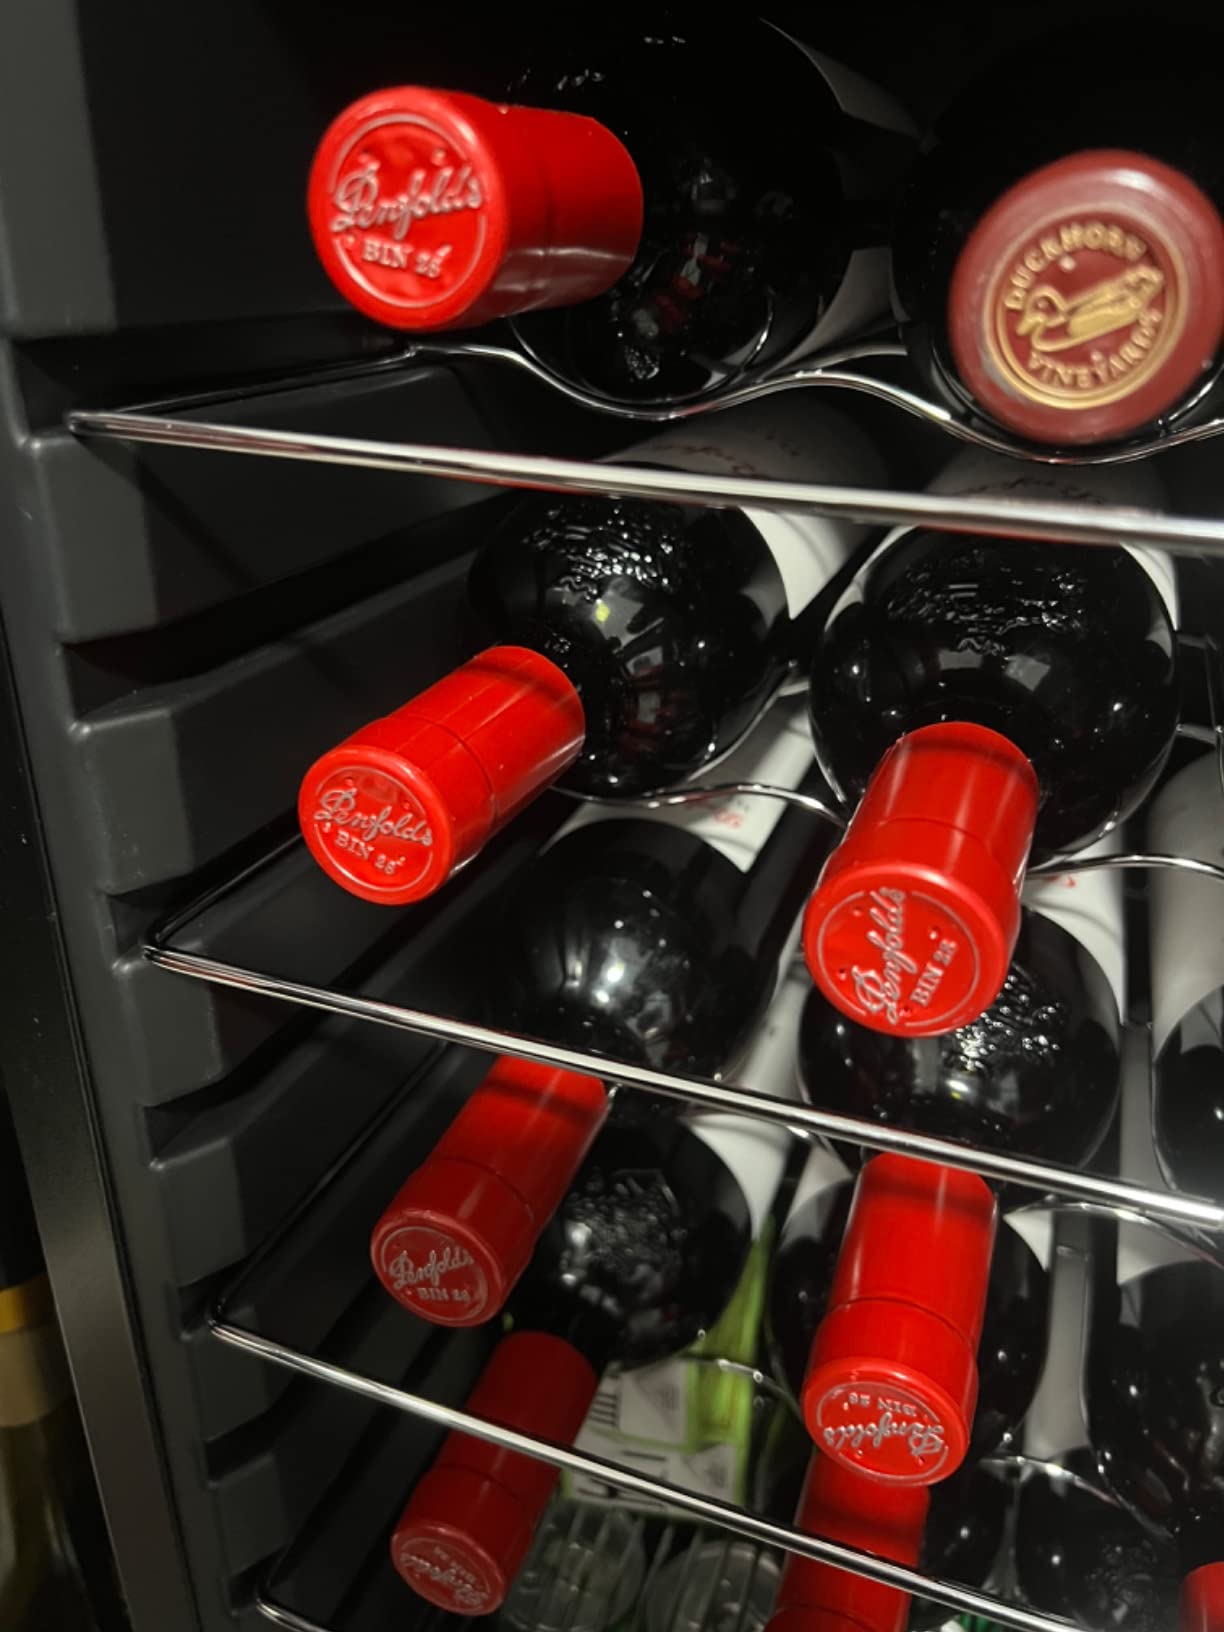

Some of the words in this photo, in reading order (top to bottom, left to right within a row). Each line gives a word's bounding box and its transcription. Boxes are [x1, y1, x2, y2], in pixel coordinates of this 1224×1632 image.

[330, 161, 483, 240] Penfolds
[362, 238, 412, 268] BIN
[1004, 221, 1147, 311] DUCKHORN
[1029, 309, 1162, 388] VINEYARDS
[313, 787, 433, 847] Penfolds
[335, 829, 374, 860] BIN
[851, 886, 918, 1025] Penfolds
[909, 961, 944, 1007] BIN
[388, 1247, 475, 1290] Penfolds
[877, 1396, 918, 1417] BIN
[823, 1412, 945, 1456] Penfolds
